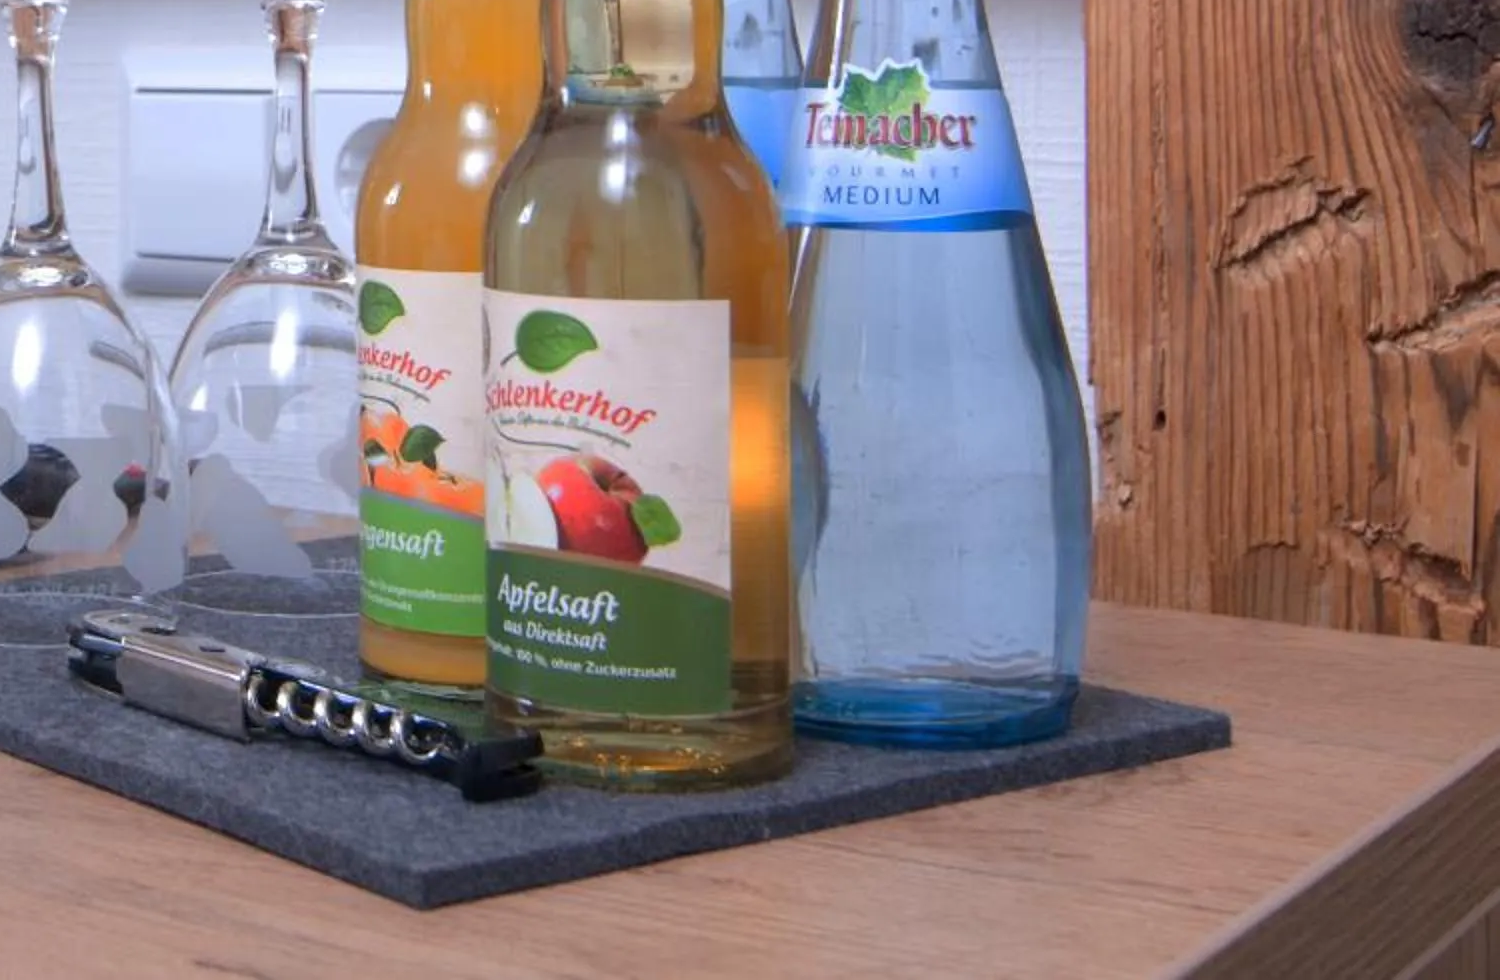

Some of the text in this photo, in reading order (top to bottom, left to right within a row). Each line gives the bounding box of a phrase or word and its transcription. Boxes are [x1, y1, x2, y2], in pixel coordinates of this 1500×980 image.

[823, 184, 940, 205] MEDIUM
[485, 379, 657, 434] Schlenkerhof
[497, 573, 620, 626] Apfelsaft
[503, 619, 522, 636] aus
[526, 621, 608, 651] Direktsaft
